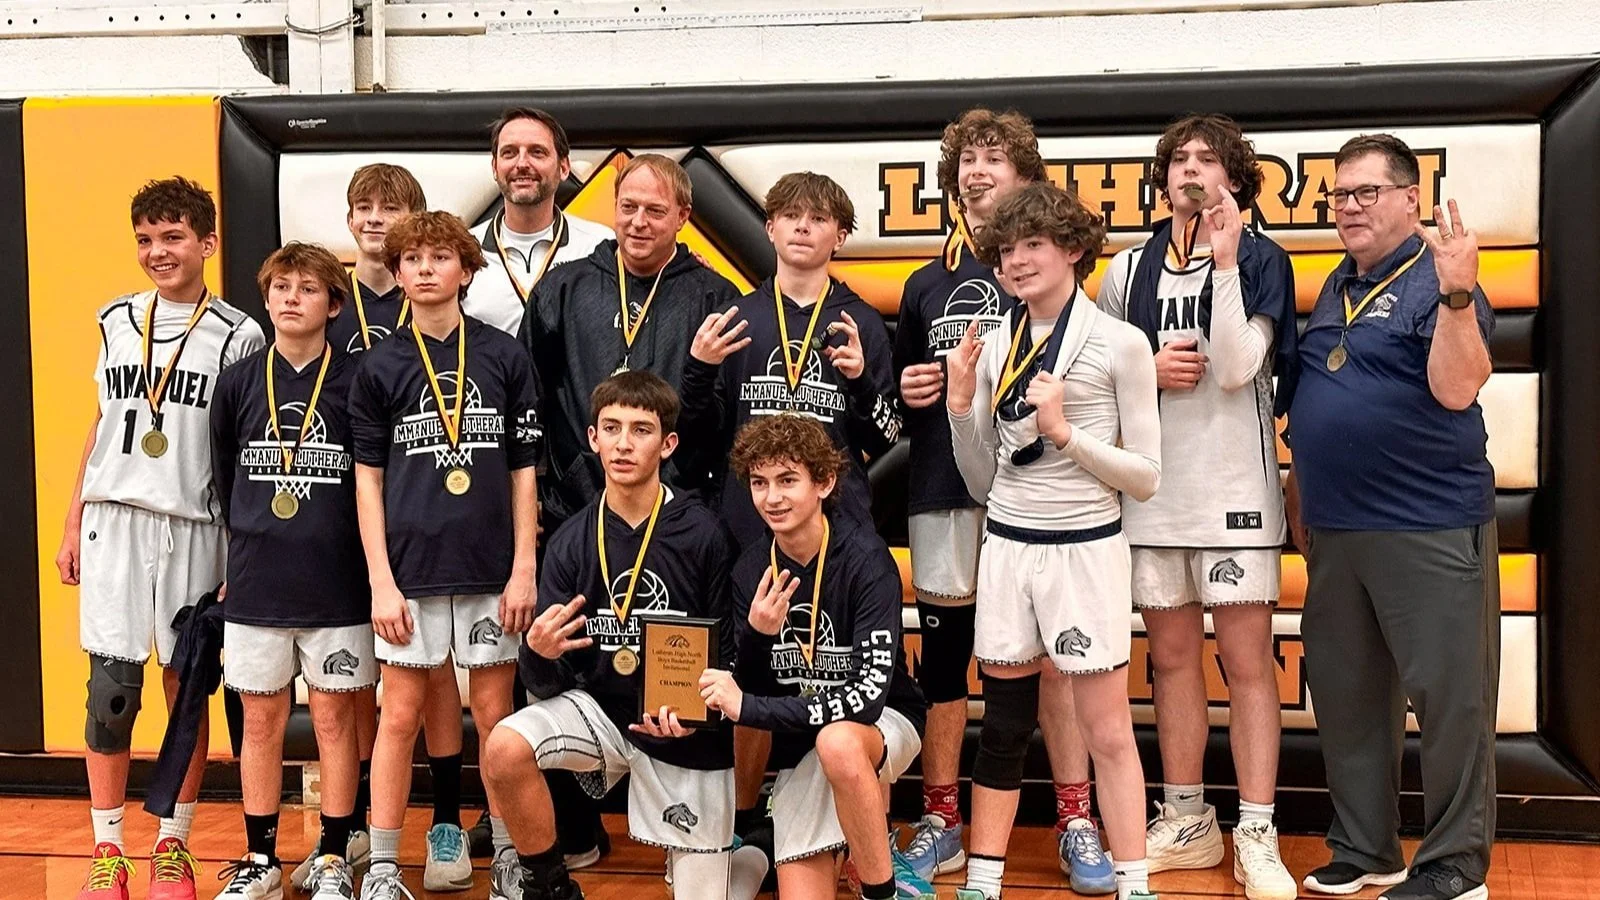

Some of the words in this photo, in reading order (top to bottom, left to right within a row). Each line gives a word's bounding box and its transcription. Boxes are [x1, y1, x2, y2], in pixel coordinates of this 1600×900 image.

[740, 383, 792, 401] MMANUEL
[394, 418, 445, 443] IMMANUE
[249, 466, 341, 477] BASKTBALL
[659, 679, 692, 688] CHAMPION
